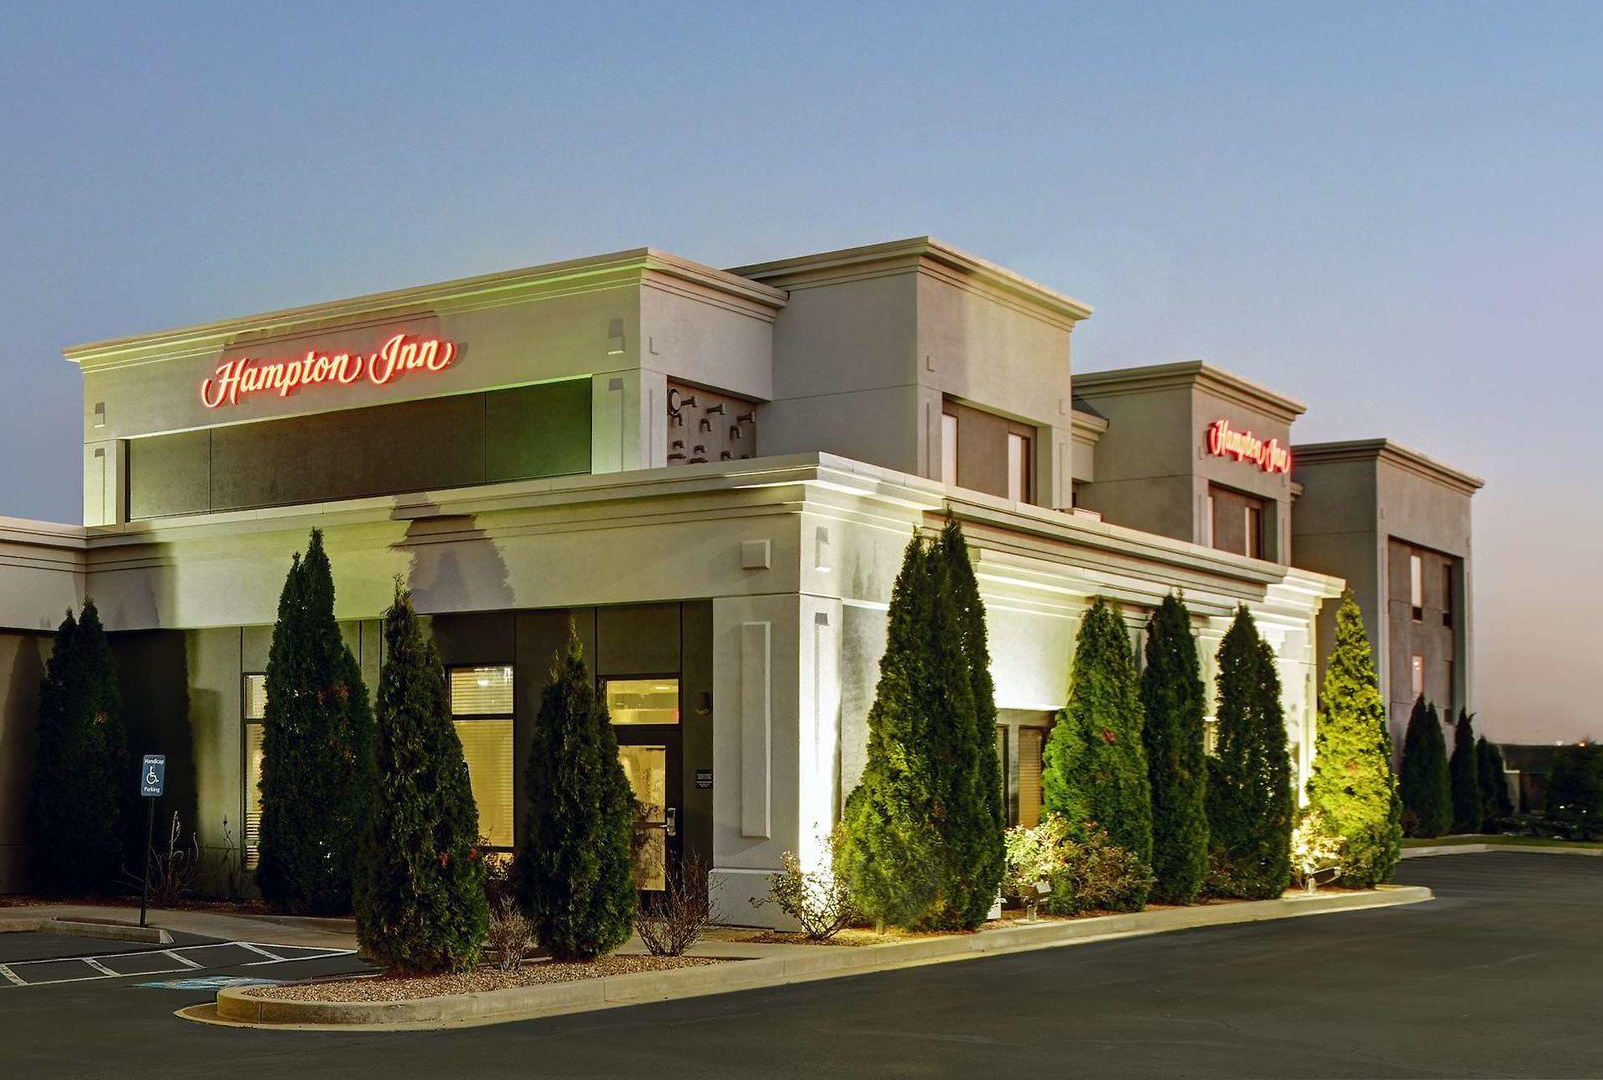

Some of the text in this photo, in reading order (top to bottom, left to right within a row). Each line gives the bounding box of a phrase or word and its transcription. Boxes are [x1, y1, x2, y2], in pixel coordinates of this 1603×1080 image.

[201, 334, 455, 408] Hampton Inn
[1208, 419, 1291, 473] Hampton Inn
